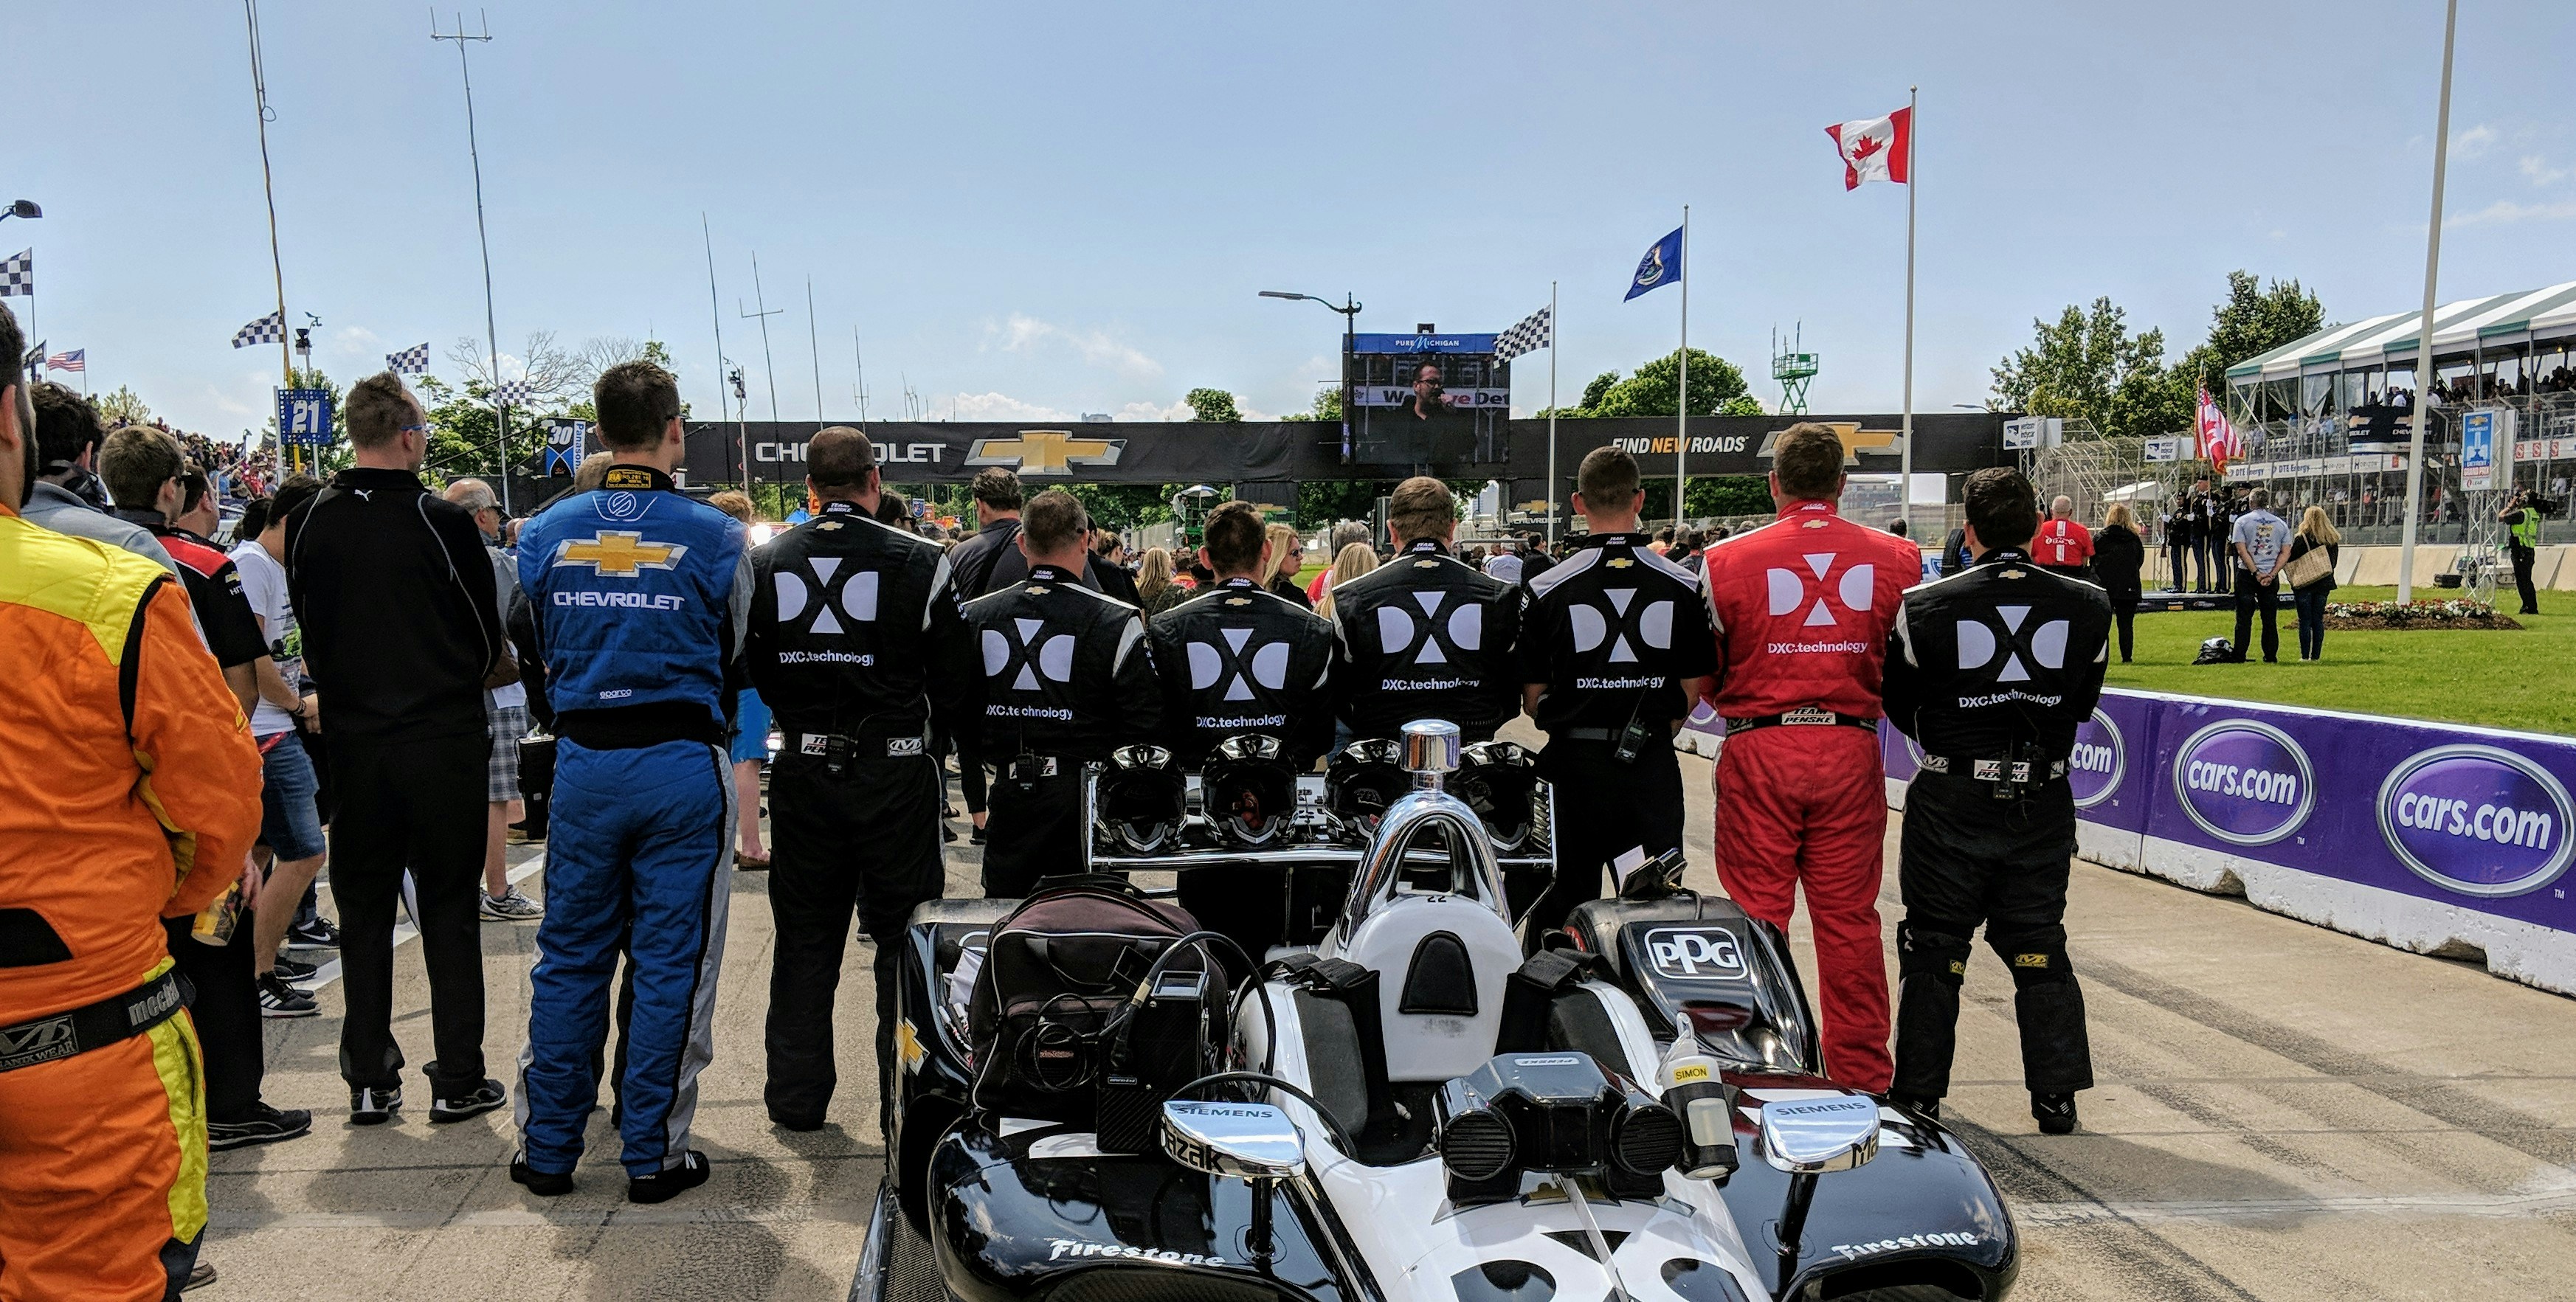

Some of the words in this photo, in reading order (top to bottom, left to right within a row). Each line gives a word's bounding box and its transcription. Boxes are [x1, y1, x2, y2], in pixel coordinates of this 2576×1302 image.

[1408, 336, 1460, 351] MICHIGAN
[291, 400, 320, 434] 21
[548, 426, 573, 446] 30
[755, 443, 947, 463] CHOLET
[1612, 438, 1651, 454] FIND
[1651, 437, 1691, 454] NEW
[553, 592, 685, 611] CHEVROLET
[1768, 640, 1868, 654] DXC.technology
[779, 650, 874, 666] DXC.technology
[599, 689, 632, 699] sparco
[1958, 689, 2061, 707] DXC.technology
[986, 704, 1073, 720] XC.technology
[1196, 715, 1286, 728] DXC.technology
[1976, 771, 2024, 780] PENKE
[2188, 760, 2296, 806] cars.com
[2398, 792, 2552, 850] cars.com
[1652, 935, 1739, 974] PPG
[37, 1040, 75, 1060] WEAR
[1676, 1068, 1707, 1080] SIMON
[1177, 1107, 1274, 1118] SIEMENS
[1776, 1102, 1867, 1115] SIEMENS
[1049, 1239, 1226, 1267] Firestone
[1831, 1231, 1979, 1261] Firestone
